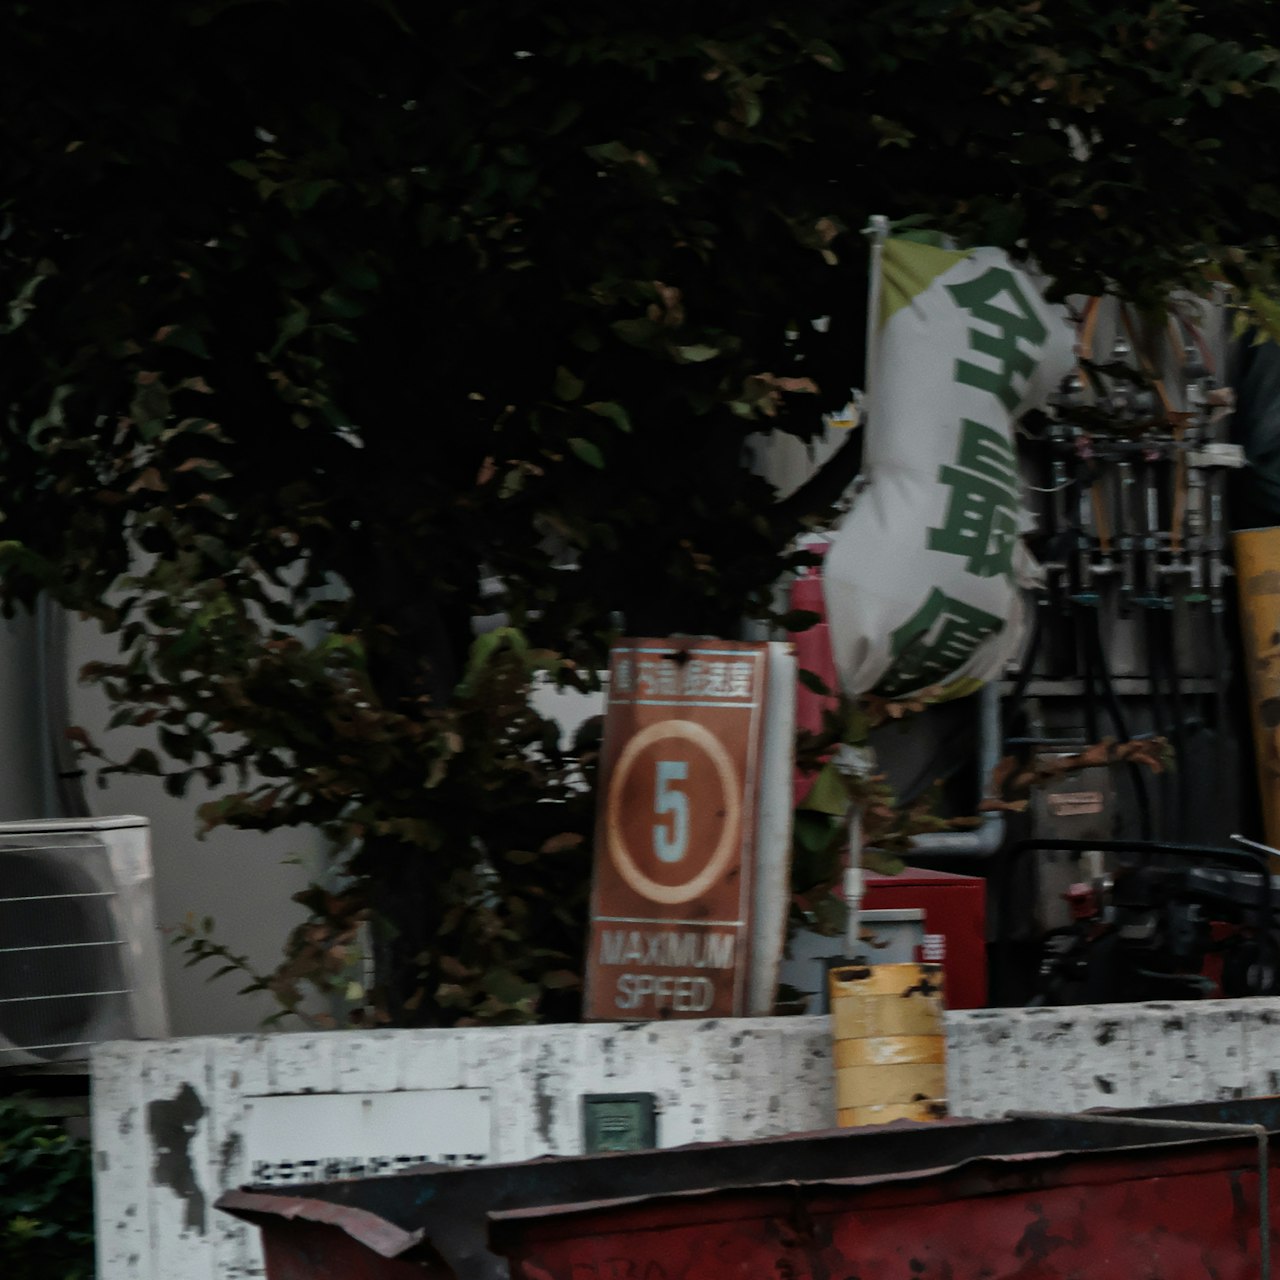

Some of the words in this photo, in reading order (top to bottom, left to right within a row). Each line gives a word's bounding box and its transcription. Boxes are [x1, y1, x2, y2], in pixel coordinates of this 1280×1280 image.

[653, 761, 690, 863] 5
[600, 929, 736, 968] MAXIMUM
[614, 972, 716, 1012] SPEED
